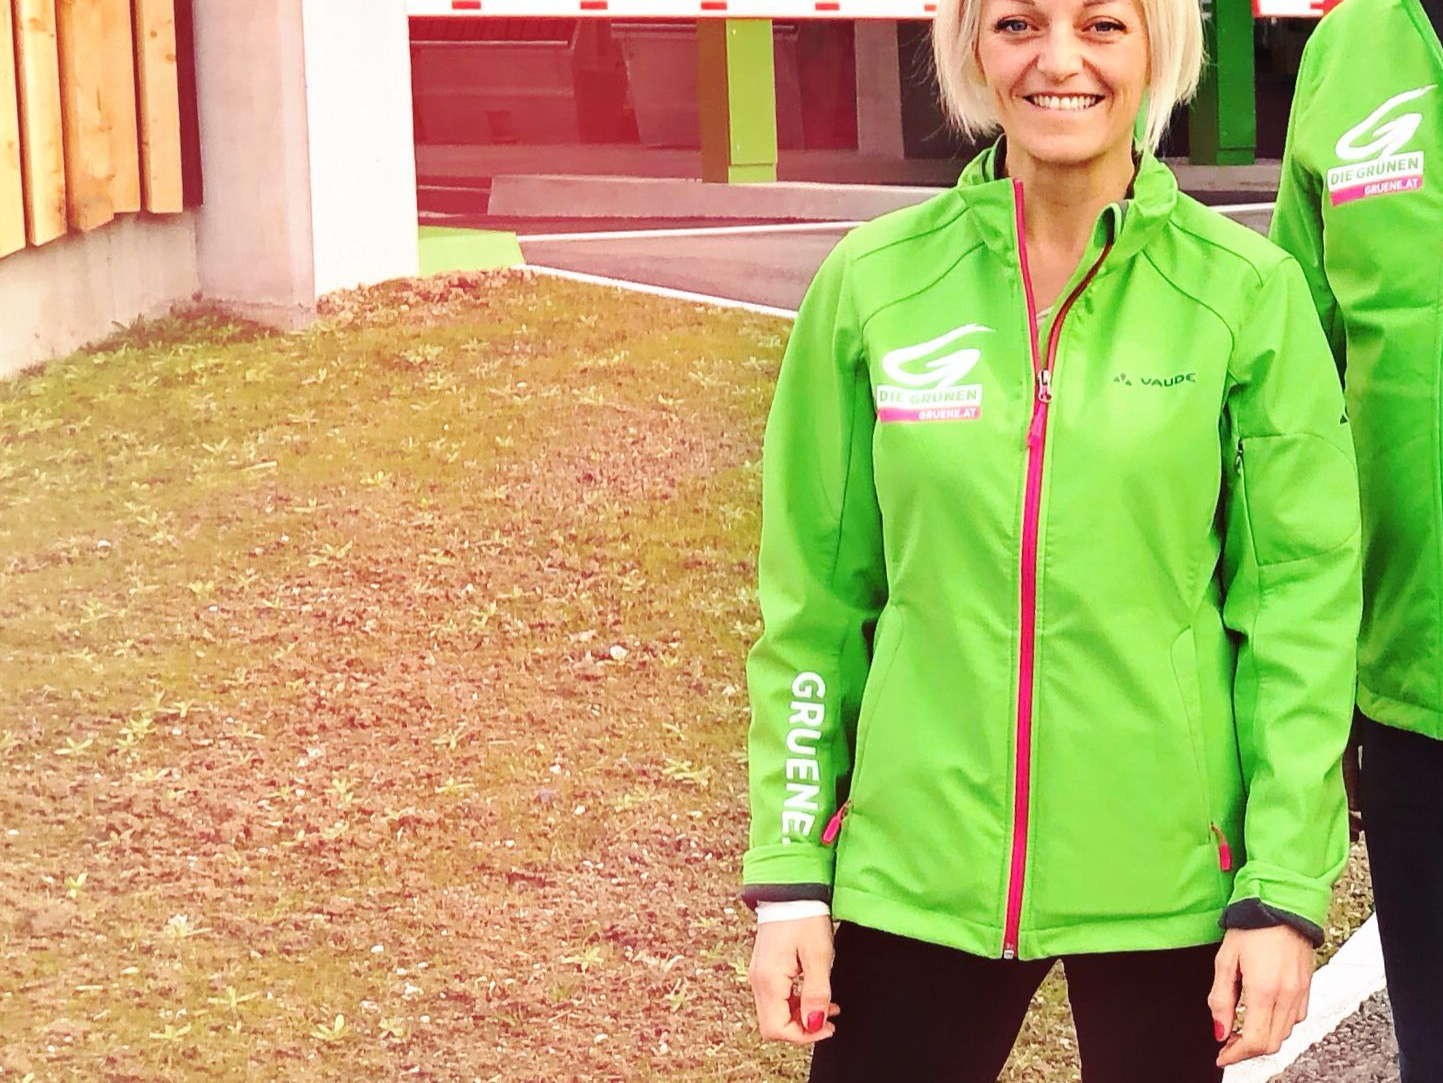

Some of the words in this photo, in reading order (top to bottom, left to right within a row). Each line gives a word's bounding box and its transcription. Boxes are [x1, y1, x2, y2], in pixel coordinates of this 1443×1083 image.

[1330, 169, 1353, 186] DIE
[1363, 178, 1419, 195] GRUENE.AT
[1140, 372, 1196, 388] VAUDE
[879, 389, 904, 403] DIE
[918, 407, 977, 421] GRUENE.AT
